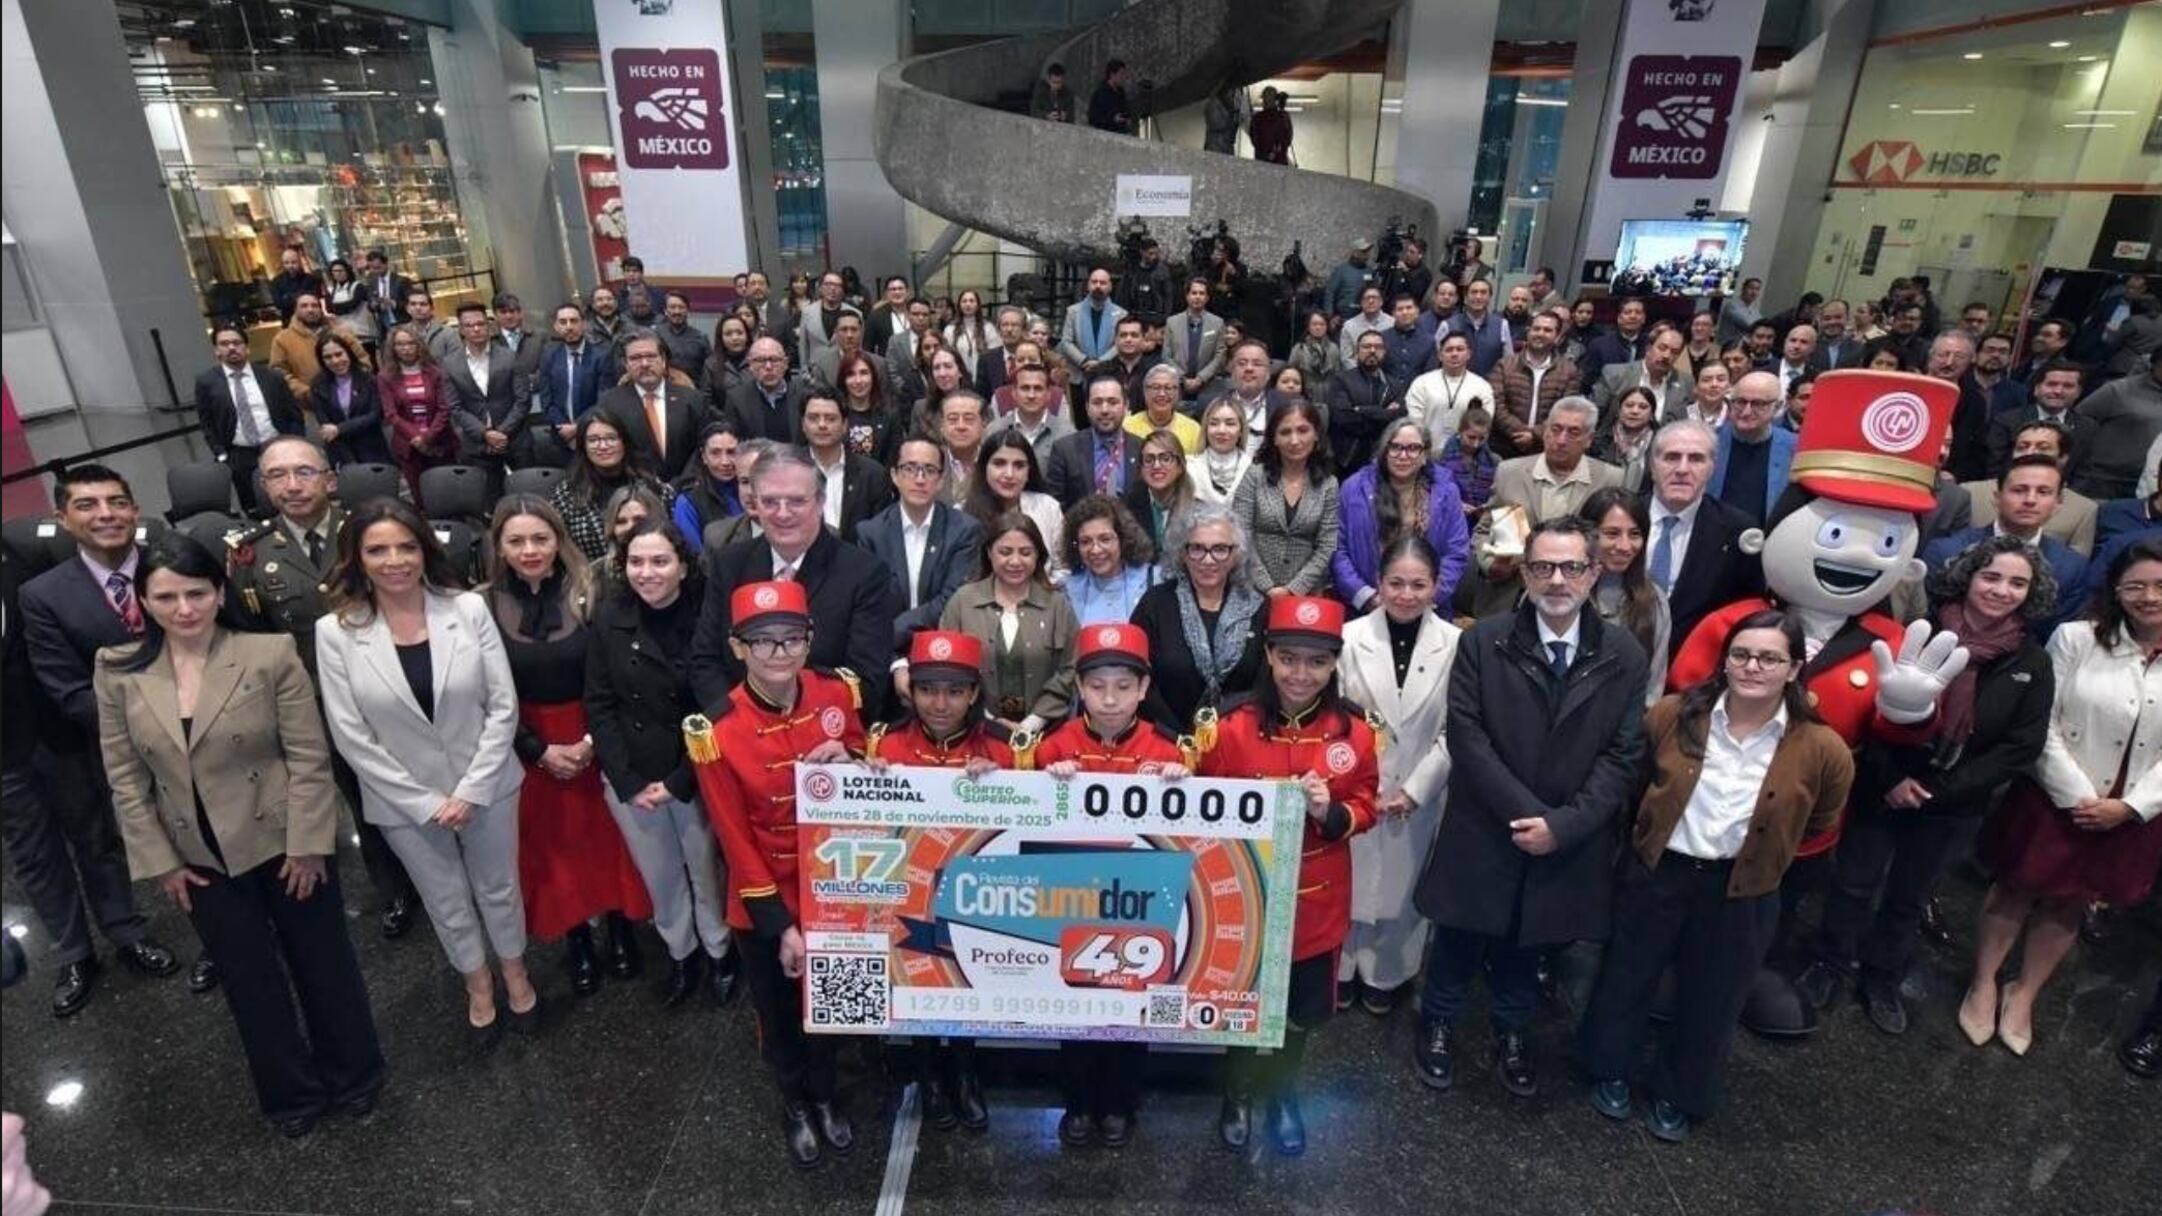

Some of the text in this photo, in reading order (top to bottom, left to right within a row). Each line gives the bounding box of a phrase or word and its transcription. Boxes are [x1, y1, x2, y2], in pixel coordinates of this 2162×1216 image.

[629, 65, 704, 79] HECHO EN
[1643, 72, 1724, 86] HECHO EN
[638, 135, 712, 156] MÉXICO
[1628, 143, 1706, 165] MÉXICO
[1927, 151, 2001, 177] HSBC
[843, 775, 912, 790] LOTERÍA
[963, 784, 1015, 795] SORTEO
[843, 789, 926, 803] NACIONAL
[962, 793, 1032, 805] SUPERIOR
[1056, 783, 1069, 820] 2865
[805, 808, 1052, 827] Viernes 28 de noviembre de 2025
[815, 837, 907, 881] 17
[813, 881, 909, 896] MILLONES
[954, 872, 1156, 920] Consumidor
[971, 947, 1050, 966] Profeco
[1070, 933, 1165, 980] 49
[910, 994, 980, 1013] 12799
